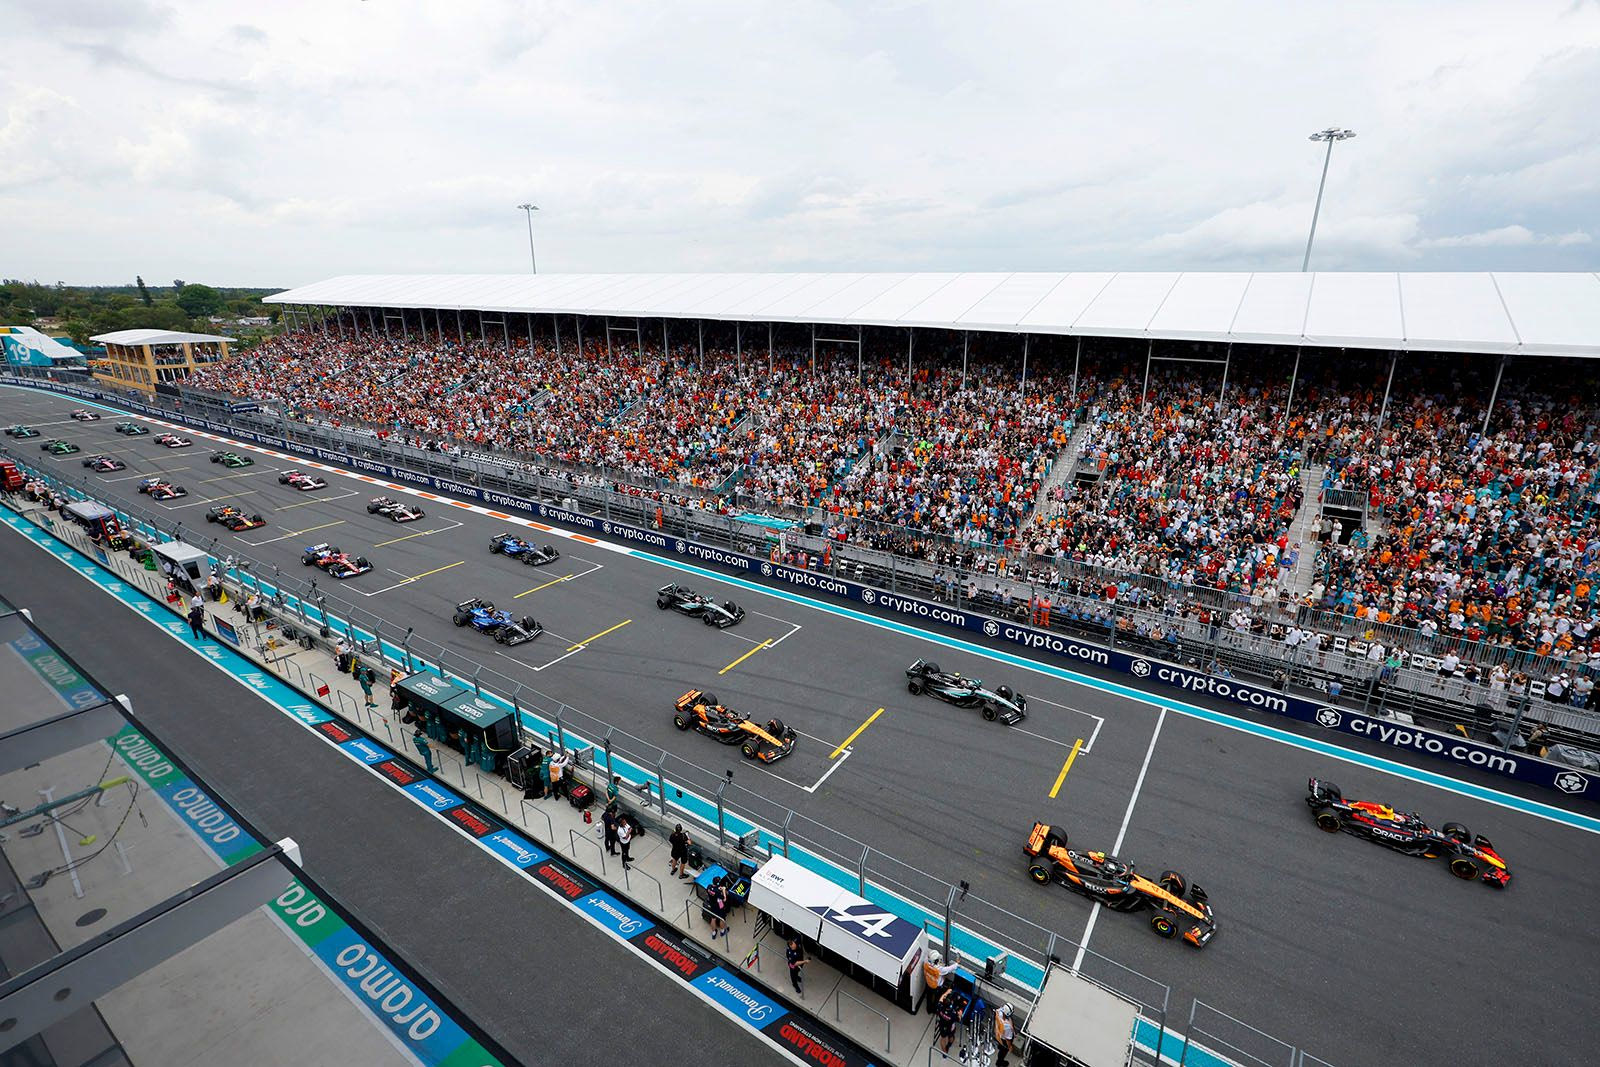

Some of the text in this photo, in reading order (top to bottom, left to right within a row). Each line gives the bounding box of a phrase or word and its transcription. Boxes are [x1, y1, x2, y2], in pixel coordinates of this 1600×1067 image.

[322, 449, 349, 464] crypto.com
[358, 459, 387, 474] crypto.com
[397, 469, 430, 485] crypto.com
[441, 480, 478, 498] crypto.com
[491, 494, 533, 512] crypto.com
[548, 508, 595, 528] crypto.com
[613, 525, 666, 547] crypto.com
[688, 546, 750, 569] crypto.com
[776, 567, 848, 595] crypto.com
[879, 592, 966, 626] crypto.com
[1004, 626, 1109, 665] crypto.com
[1157, 666, 1288, 712] crypto.com
[458, 703, 484, 718] aramco
[117, 734, 173, 778] aramco
[1349, 717, 1518, 775] crypto.com
[172, 788, 241, 843] aramco
[451, 808, 490, 835] MOBLAND
[492, 834, 538, 864] Paramount+
[538, 865, 584, 898] MOBLAND
[276, 880, 326, 927] ara
[588, 897, 642, 933] Paramount+
[644, 935, 699, 976] MOBLAND
[336, 943, 441, 1041] aramco
[707, 976, 772, 1021] Paramount+
